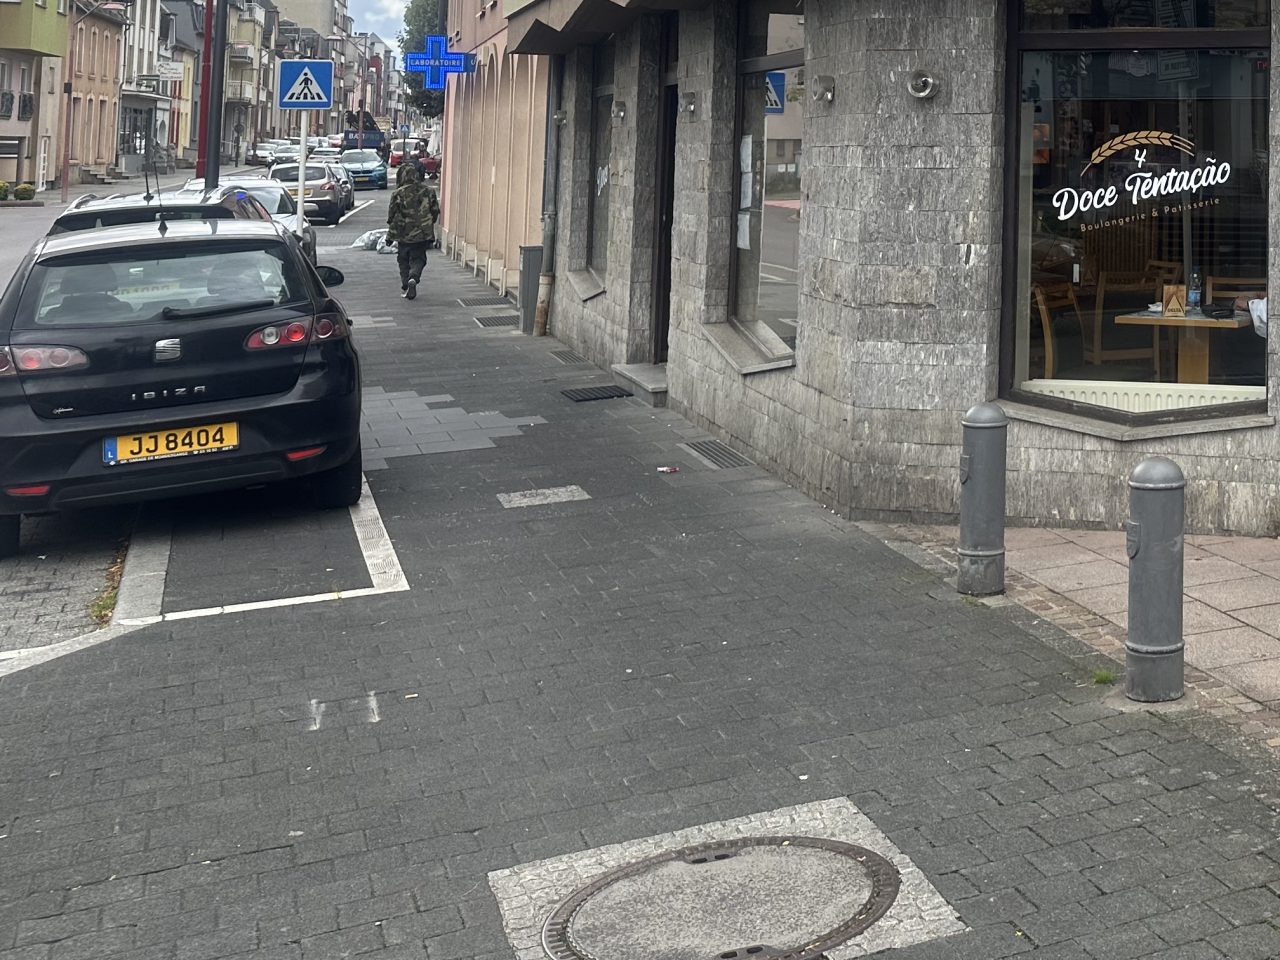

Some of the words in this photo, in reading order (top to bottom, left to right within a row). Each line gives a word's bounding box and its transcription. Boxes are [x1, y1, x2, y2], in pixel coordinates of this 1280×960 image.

[410, 59, 461, 67] LABORATOIRE
[1052, 186, 1118, 220] Doce
[1125, 157, 1231, 205] Tentação
[1080, 212, 1146, 232] Boulangerie
[1151, 208, 1159, 217] &
[1164, 197, 1221, 214] Patisserie
[131, 385, 206, 400] IBIZA
[130, 434, 159, 456] JJ
[165, 427, 225, 451] 8404
